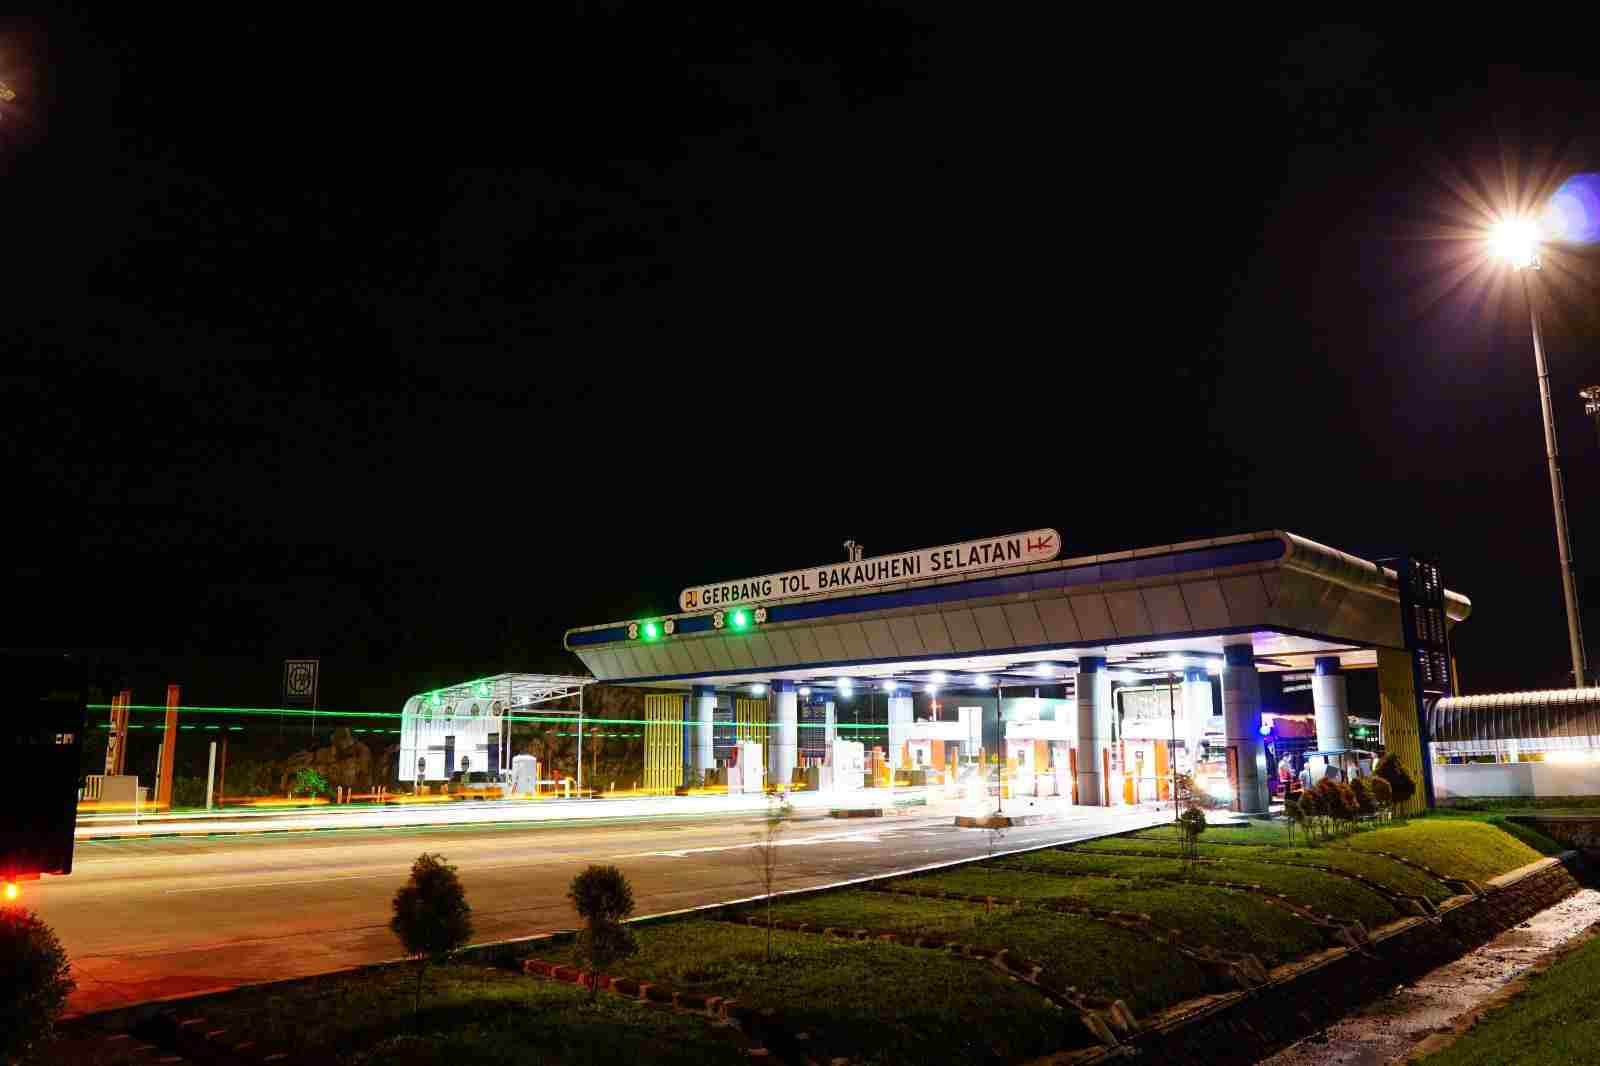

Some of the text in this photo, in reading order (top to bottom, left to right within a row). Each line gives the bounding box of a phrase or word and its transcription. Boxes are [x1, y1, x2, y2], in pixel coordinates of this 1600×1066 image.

[702, 539, 1022, 605] GERBANG TOL BAKAUHENI SELATAN
